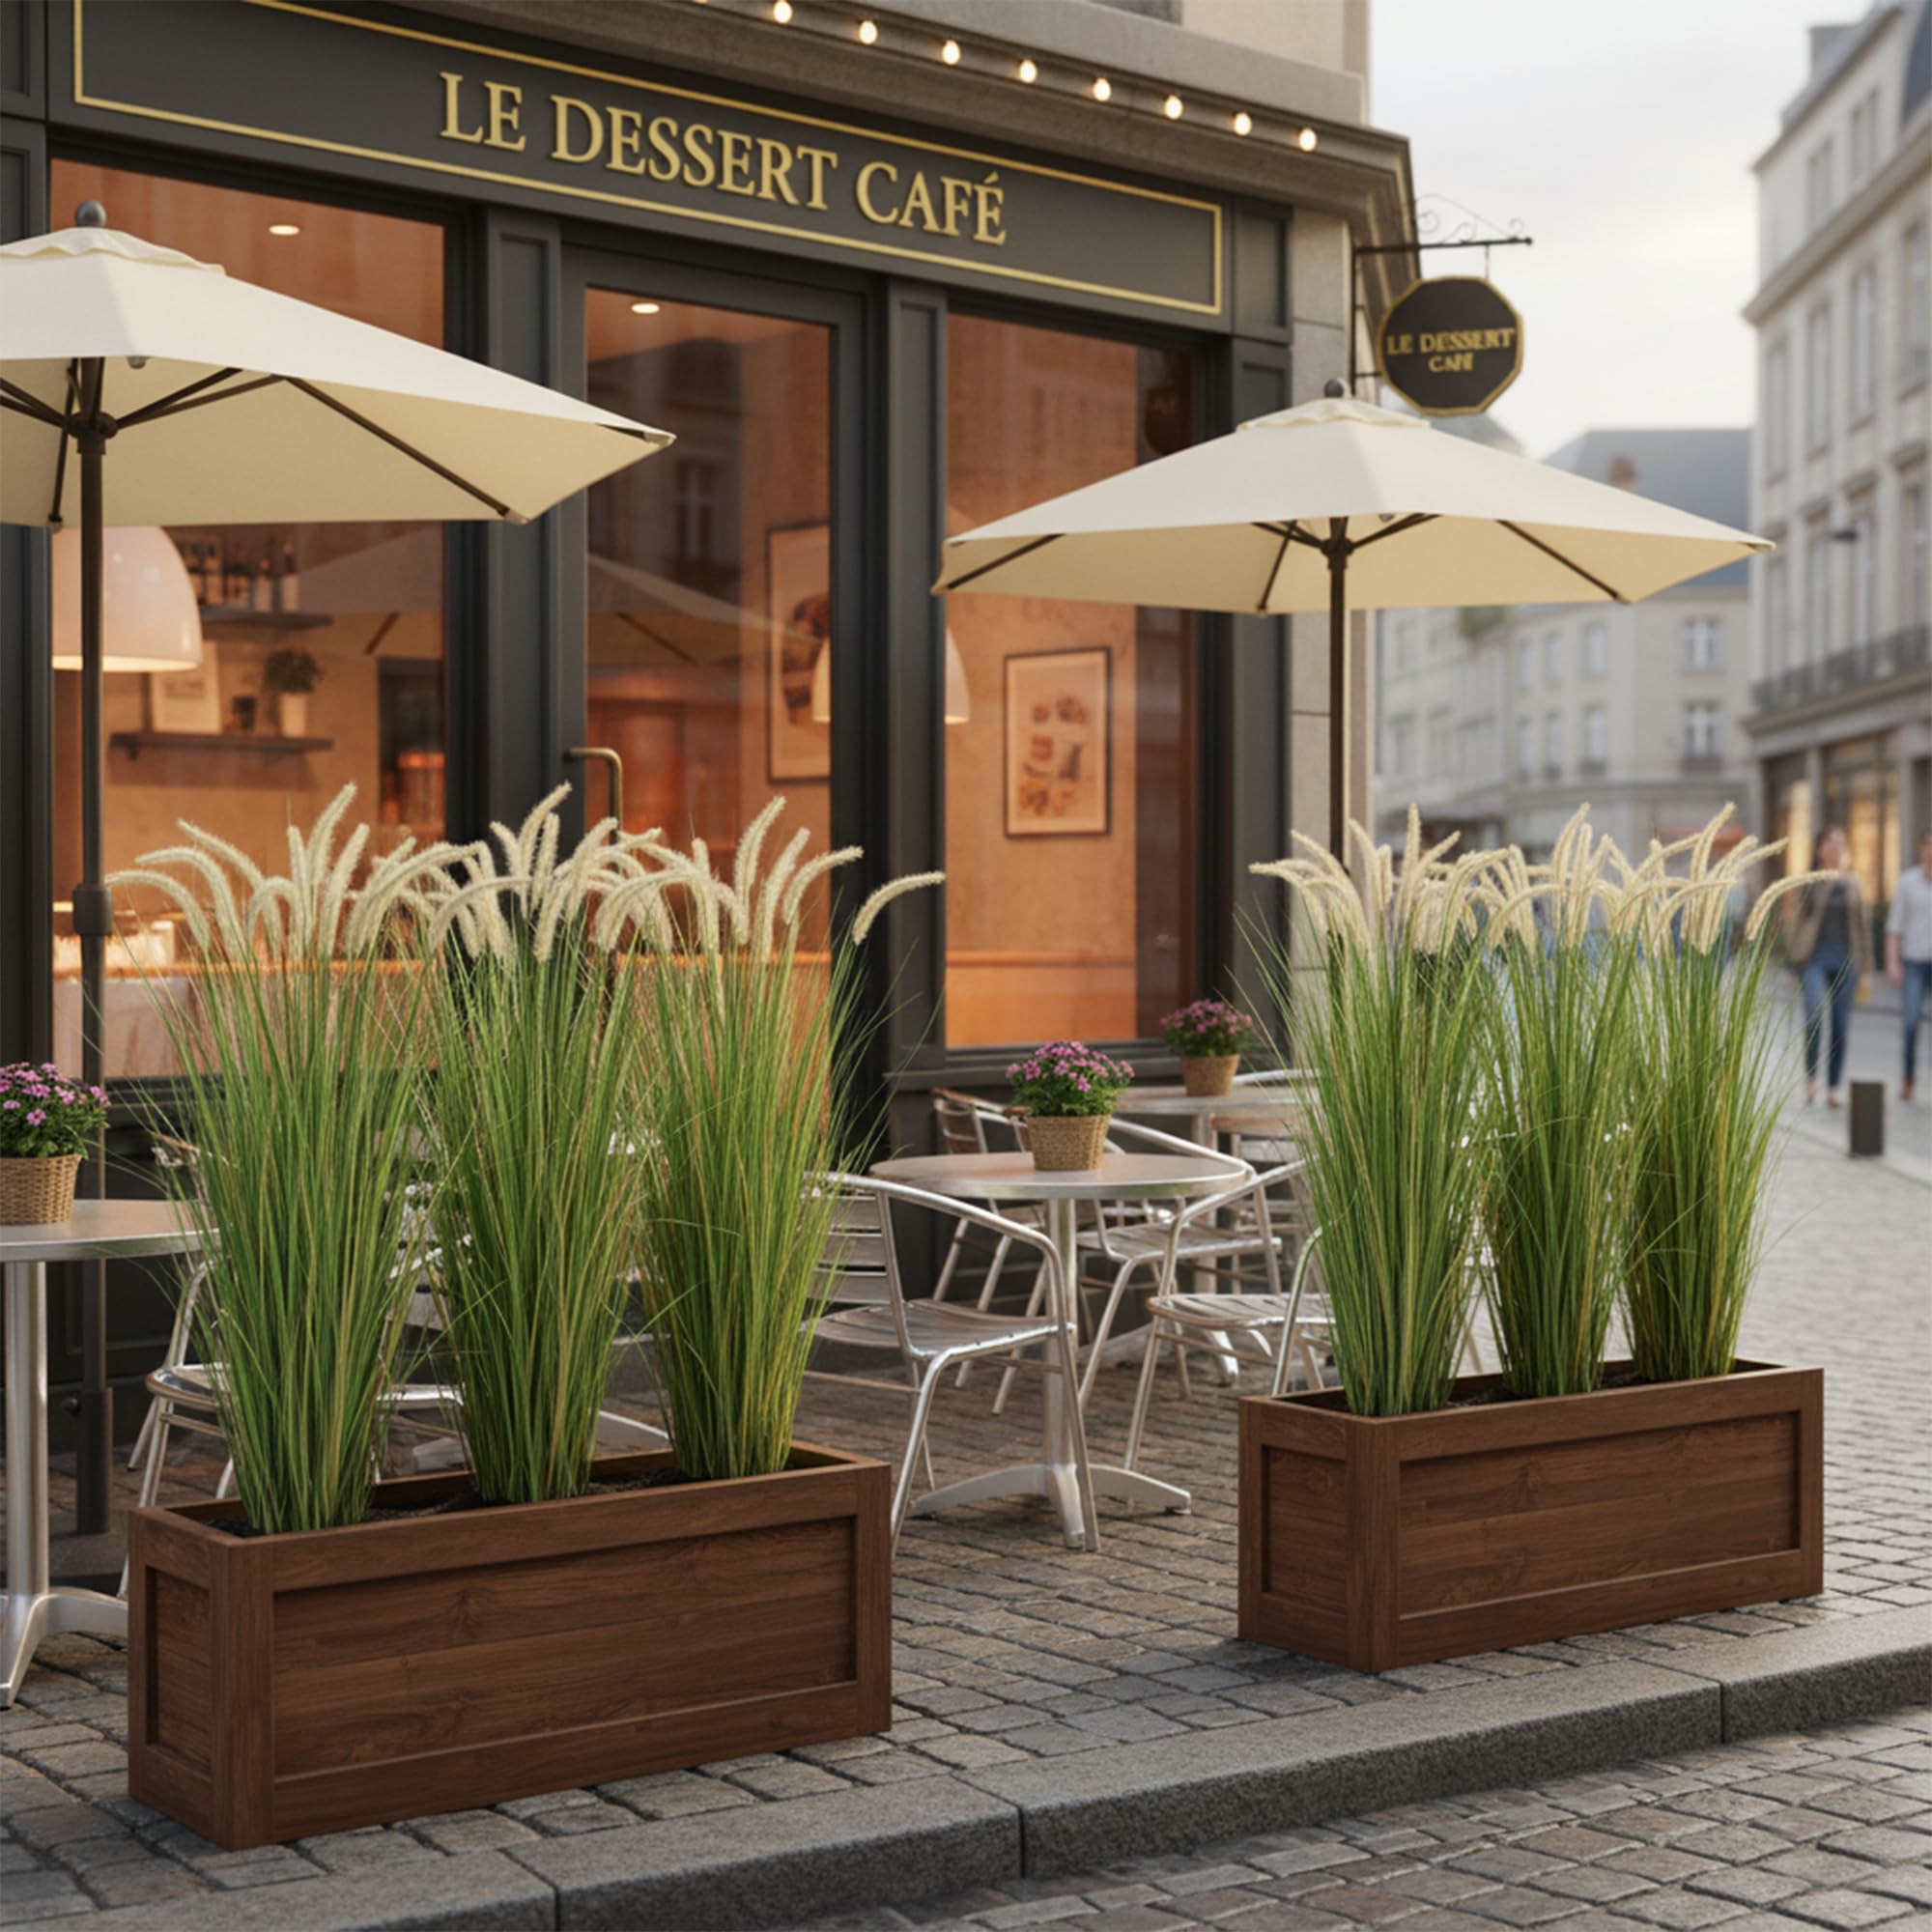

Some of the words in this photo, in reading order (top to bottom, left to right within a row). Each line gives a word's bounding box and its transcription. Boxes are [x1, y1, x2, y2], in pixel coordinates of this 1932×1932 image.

[440, 71, 527, 152] LE
[550, 94, 838, 211] DESSERT
[856, 161, 1006, 245] CAFÉ
[1386, 334, 1414, 355] LE
[1419, 327, 1516, 353] DESSERT
